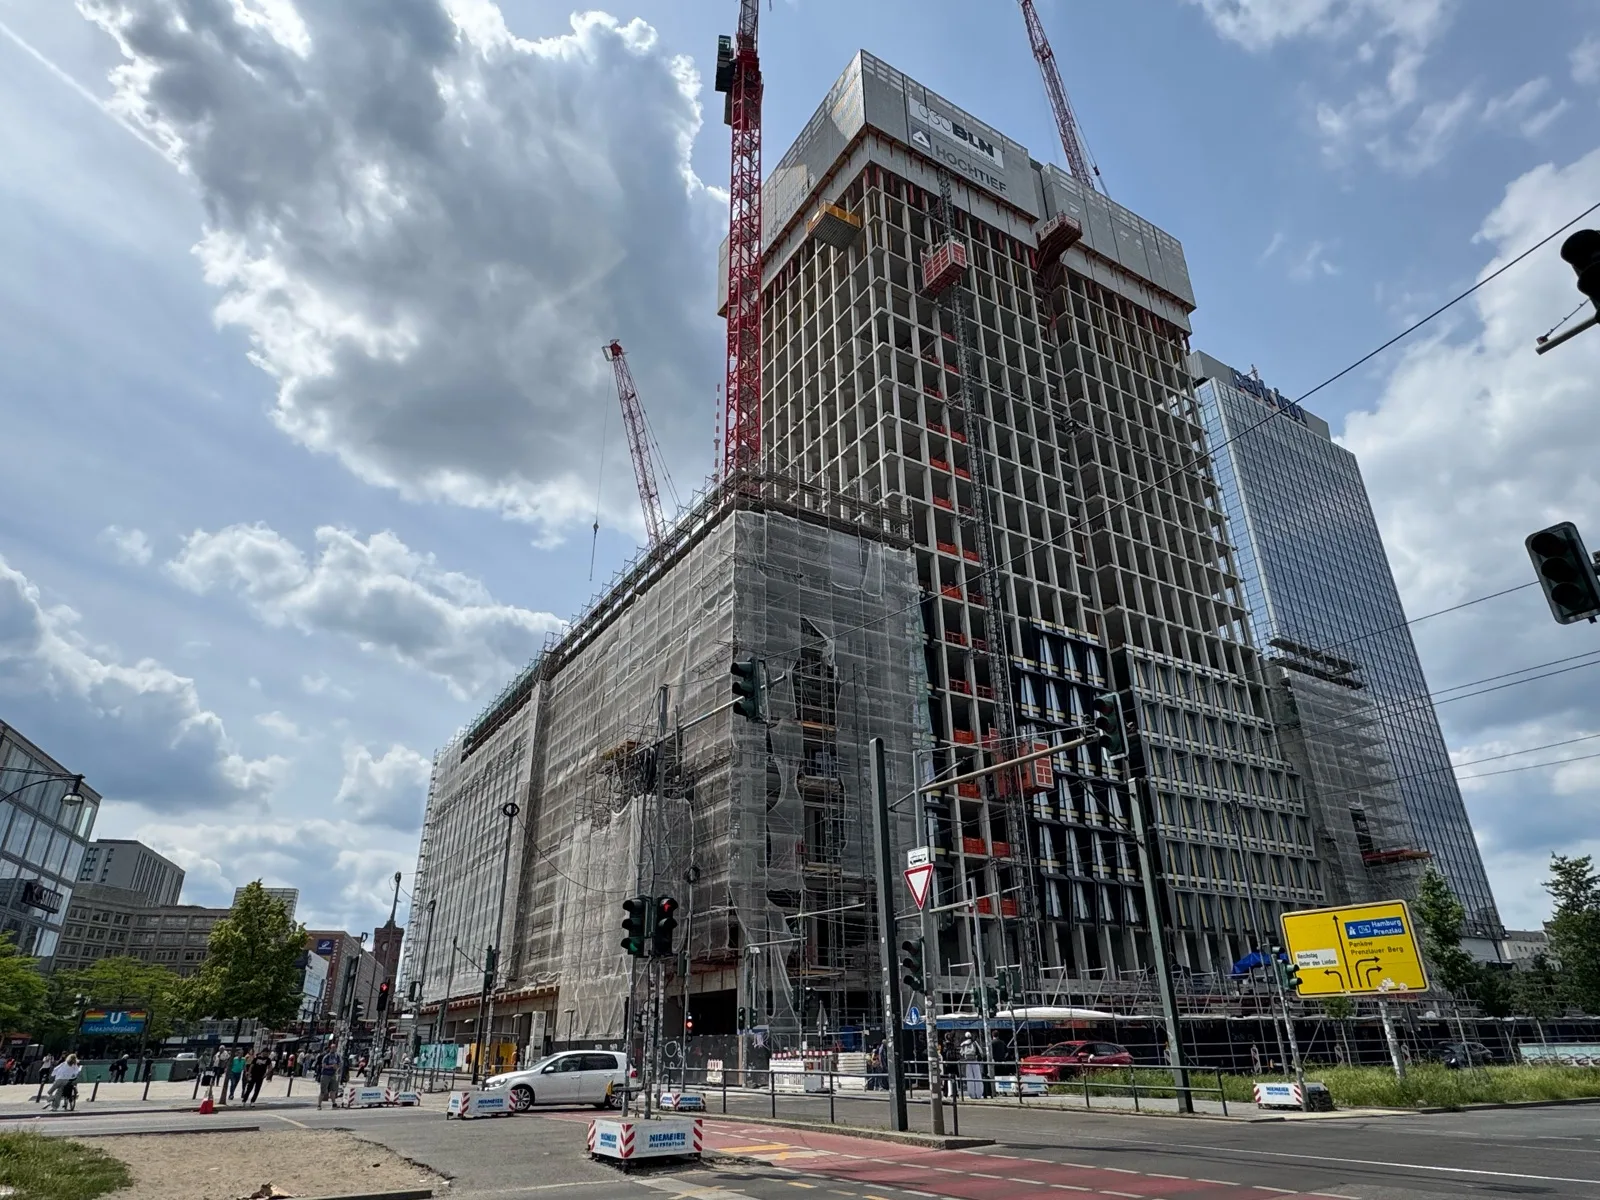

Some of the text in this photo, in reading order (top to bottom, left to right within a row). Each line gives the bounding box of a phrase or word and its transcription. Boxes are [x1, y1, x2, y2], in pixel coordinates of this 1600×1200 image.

[935, 145, 1007, 193] HOCHTIEF
[1371, 919, 1402, 928] Hamburg
[1373, 927, 1403, 936] Prenzlau
[1348, 940, 1373, 948] Pankow
[1350, 948, 1385, 956] Prenzlauer
[109, 1012, 122, 1025] U
[87, 1024, 137, 1033] Alexanderplatz
[649, 1132, 686, 1142] NIEMEIER
